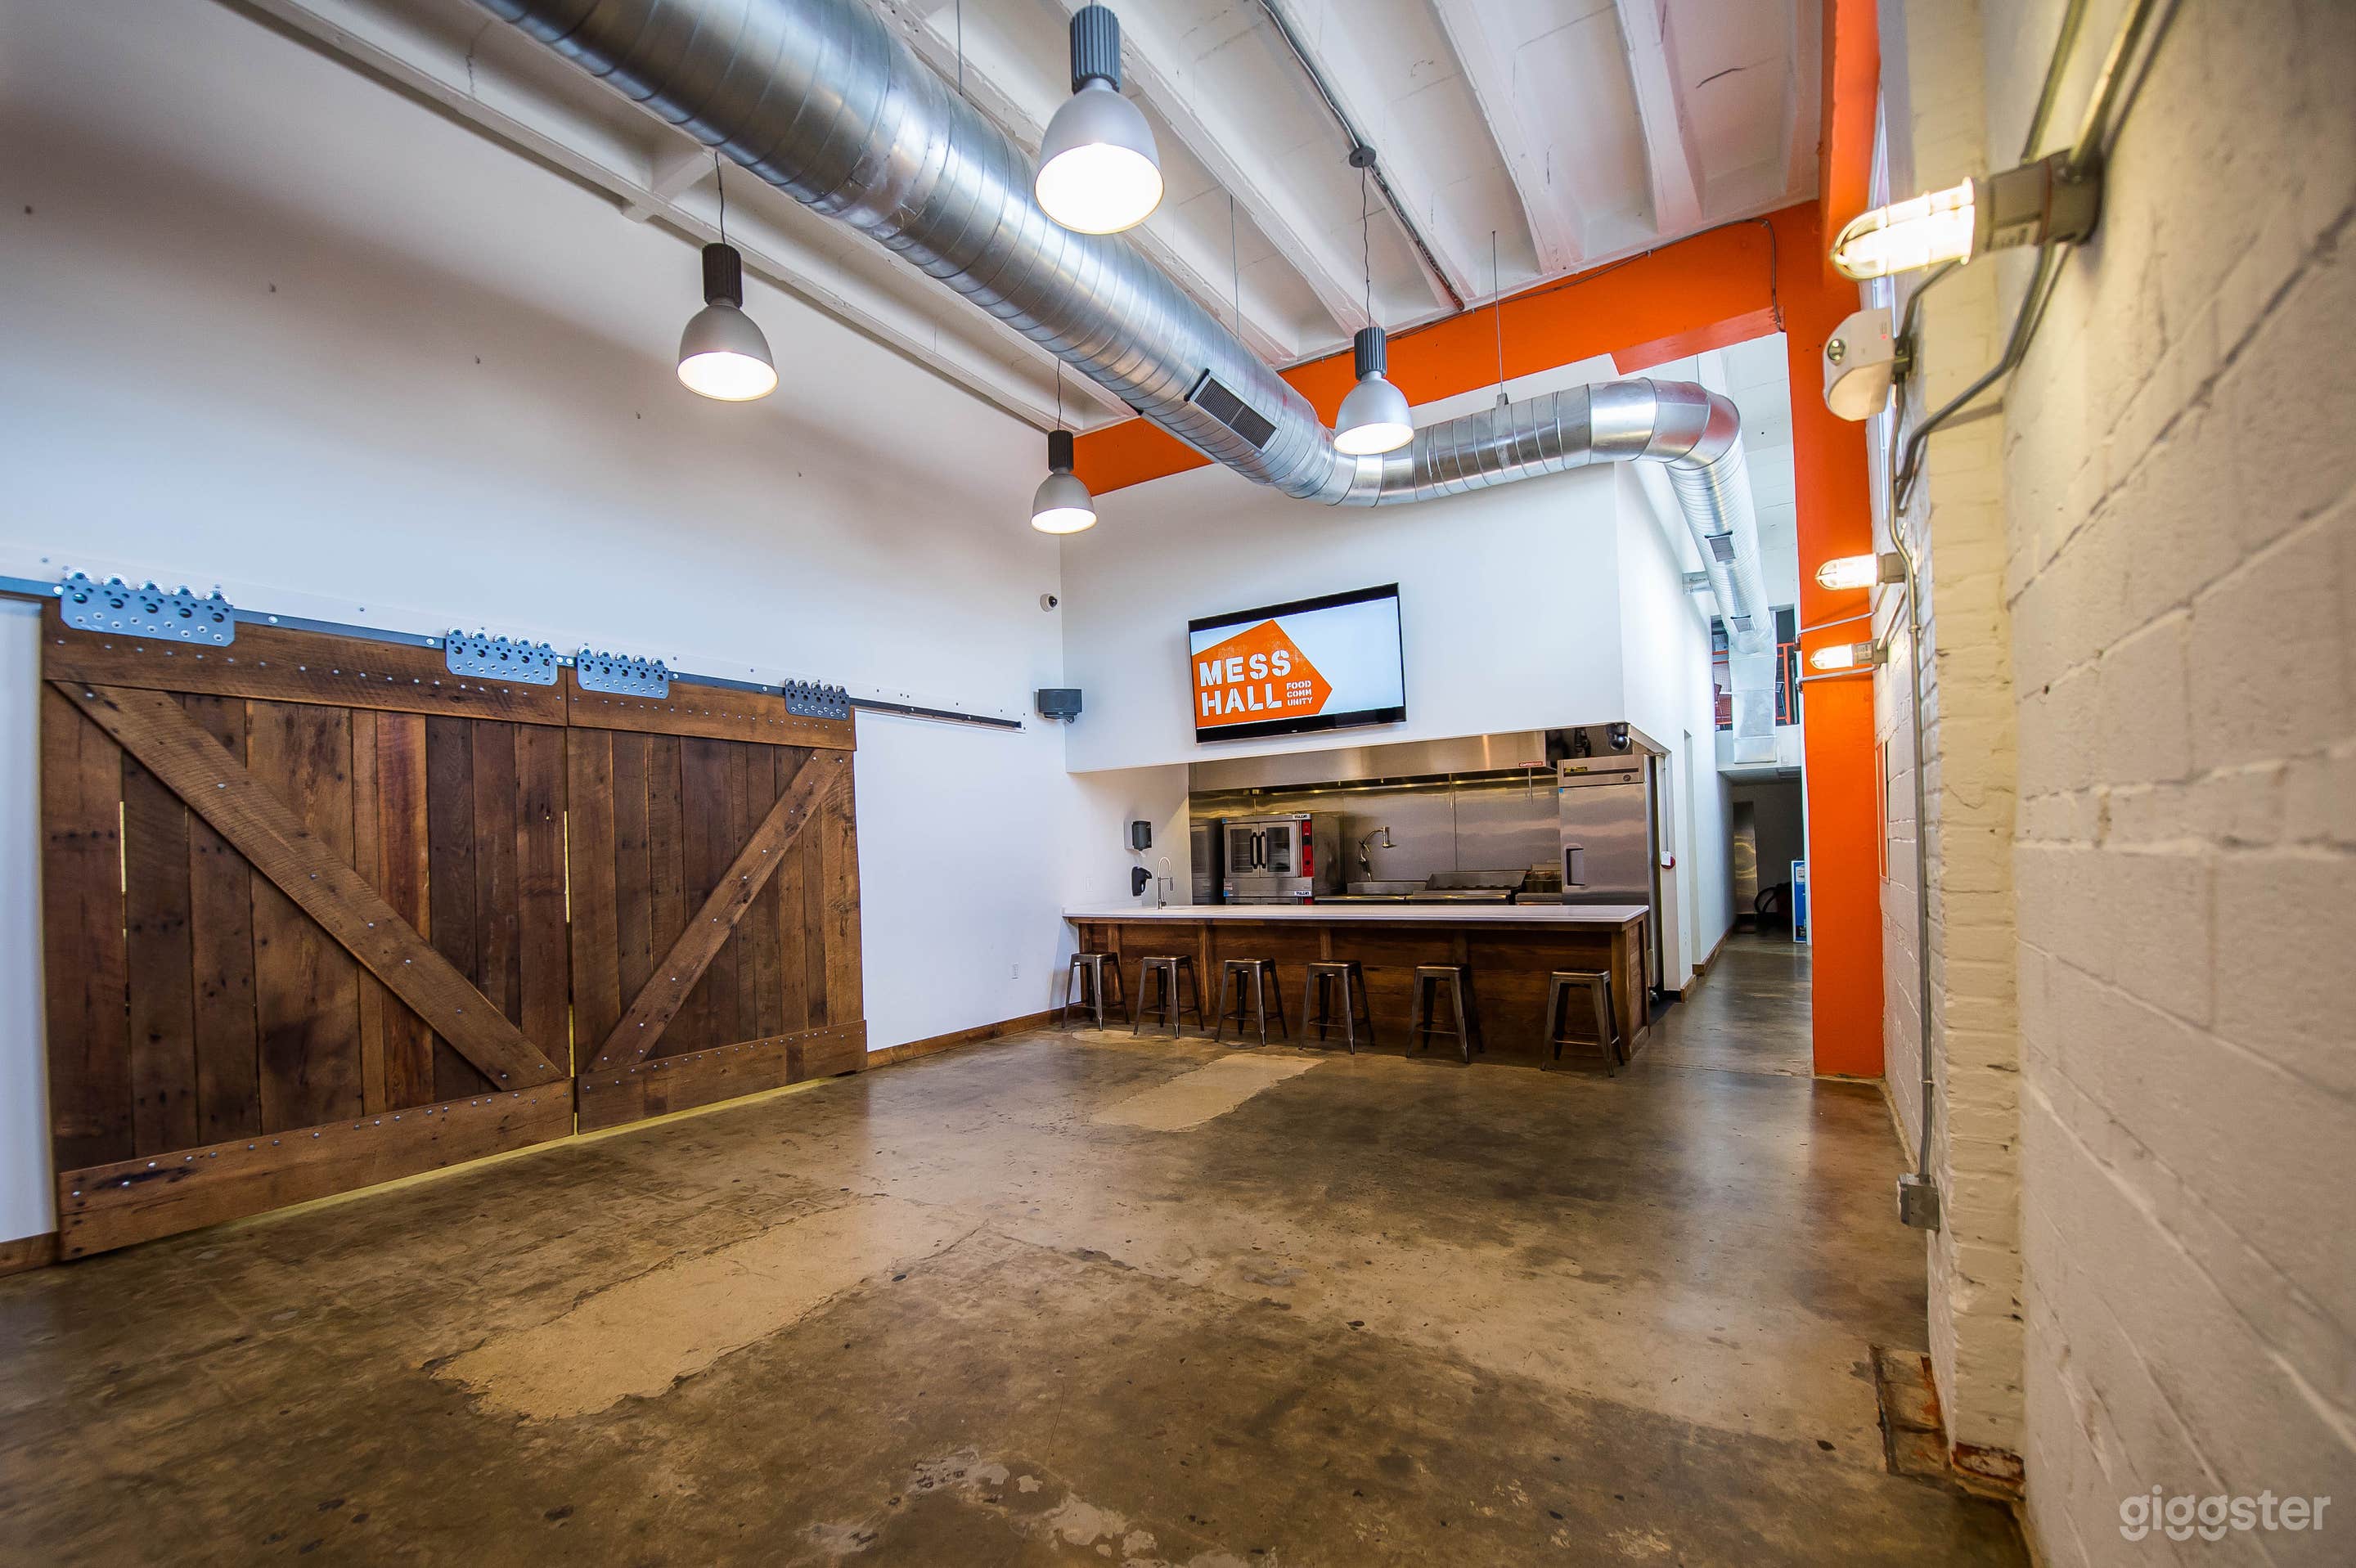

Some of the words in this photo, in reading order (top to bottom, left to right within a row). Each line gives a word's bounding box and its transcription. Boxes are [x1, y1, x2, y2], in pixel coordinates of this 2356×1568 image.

[1198, 649, 1292, 687] MESS
[1286, 680, 1312, 690] FOOD
[1286, 689, 1312, 699] COMM
[1201, 683, 1283, 717] HALL
[1287, 696, 1313, 707] UNITY
